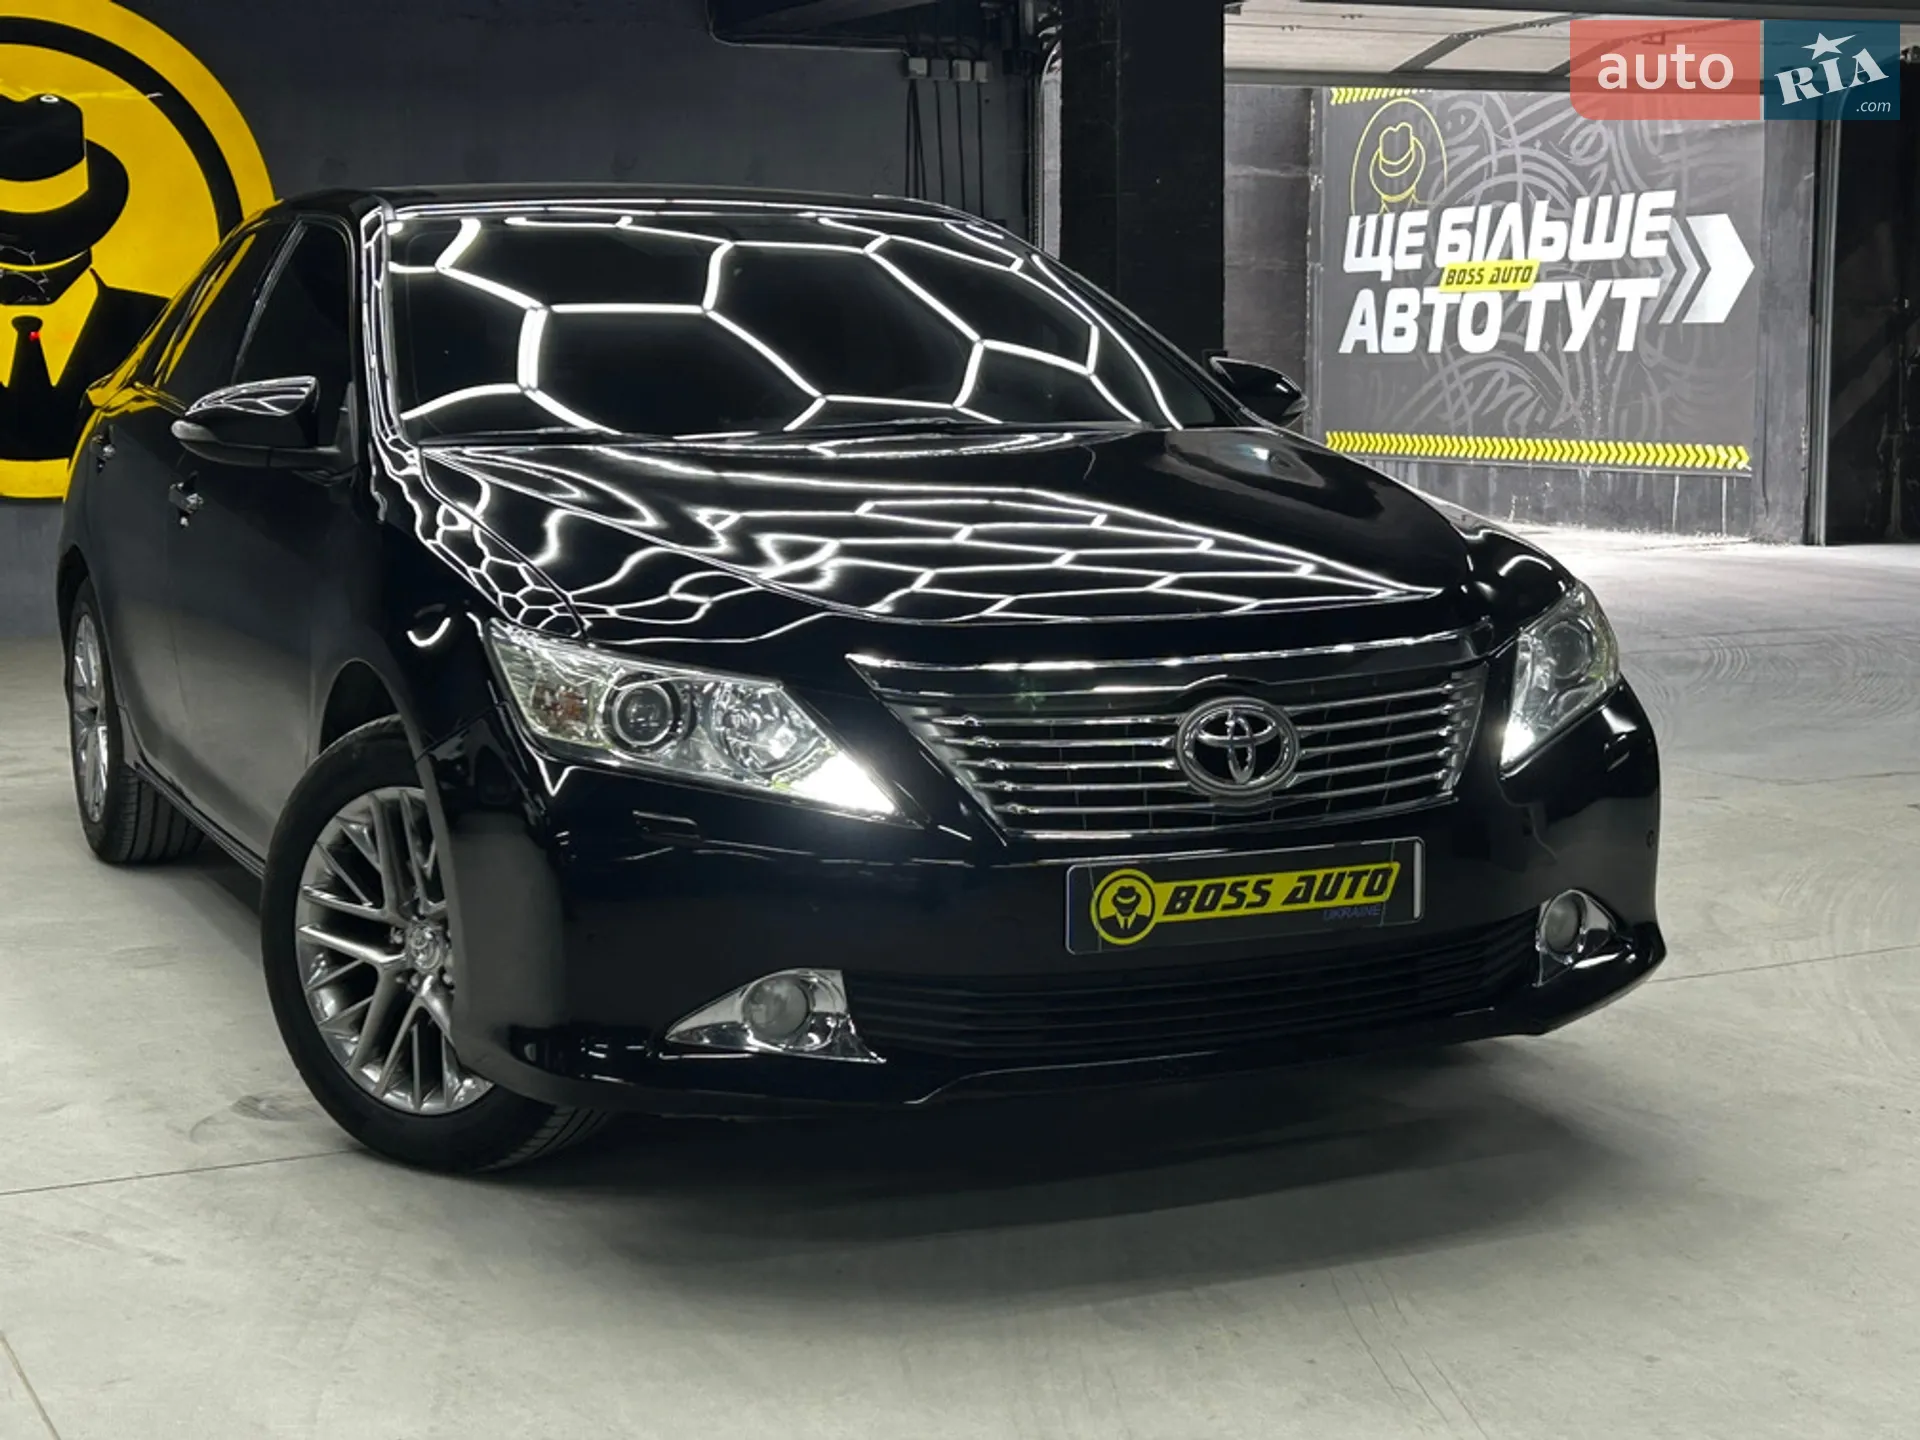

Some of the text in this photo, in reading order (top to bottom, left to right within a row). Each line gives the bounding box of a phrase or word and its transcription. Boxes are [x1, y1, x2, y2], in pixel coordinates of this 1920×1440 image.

[1342, 190, 1677, 281] ЩЕ БІЛЬШЕ
[1445, 264, 1534, 286] BOSS AUTO
[1339, 277, 1661, 353] АВТО ТУТ
[1162, 867, 1394, 915] BOSS AUTO
[1323, 905, 1381, 920] UKRAINE
